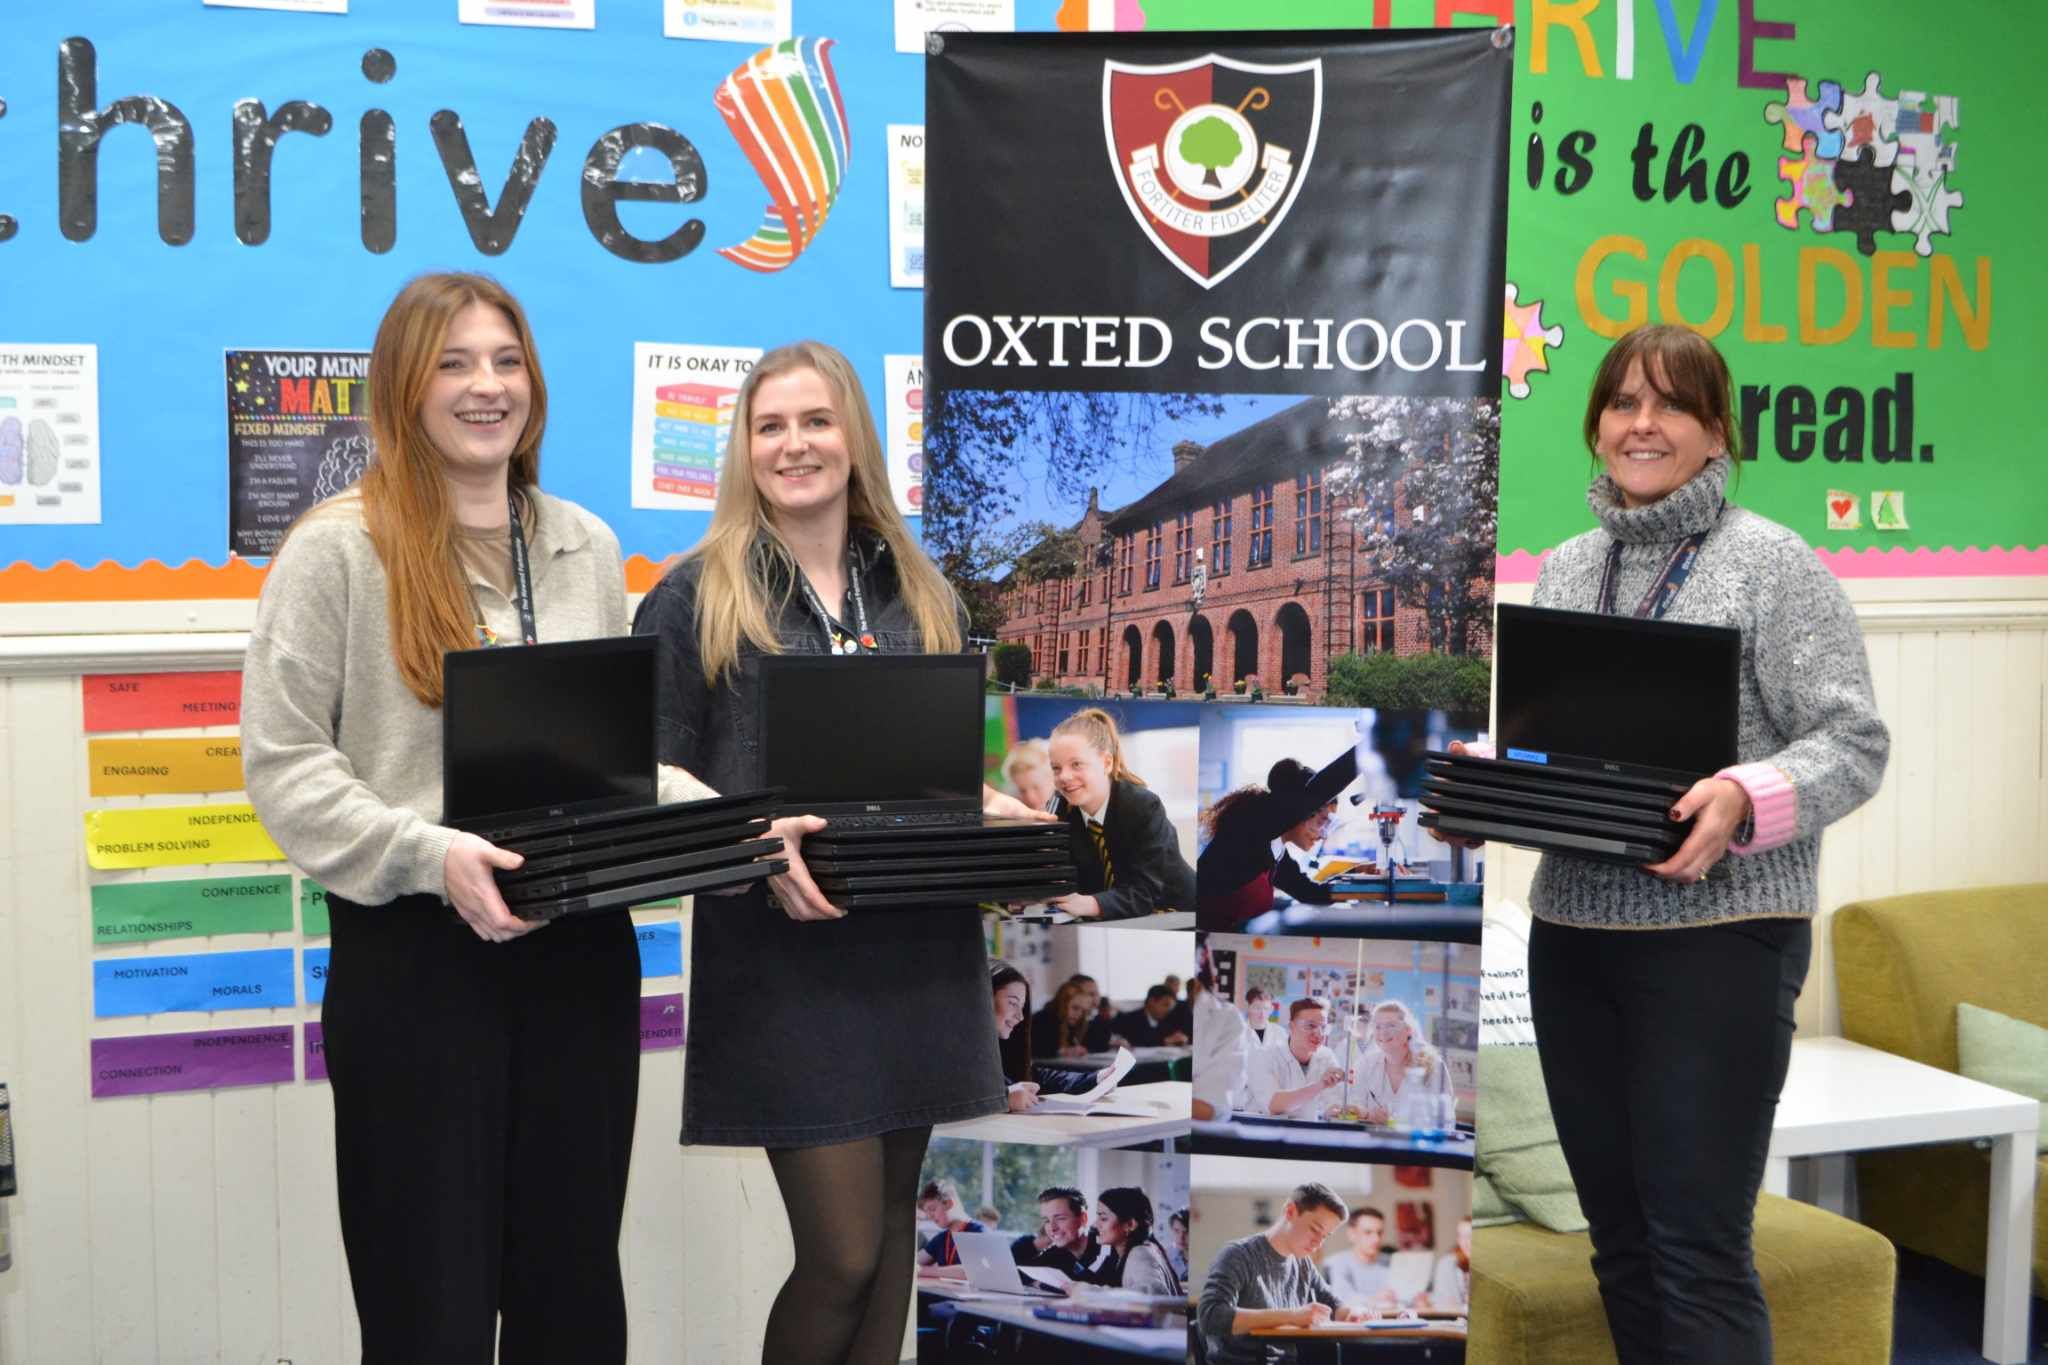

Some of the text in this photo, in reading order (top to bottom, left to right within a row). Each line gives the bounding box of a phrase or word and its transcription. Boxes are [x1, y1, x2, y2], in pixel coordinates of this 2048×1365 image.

[0, 36, 708, 264] hrive
[1526, 101, 1752, 209] is the
[1136, 169, 1286, 231] FORTITER FIDELITER
[1574, 235, 1992, 351] GOLDEN
[942, 314, 1487, 372] OXTED SCHOOL
[22, 355, 86, 367] MINDSET
[264, 355, 317, 377] YOUR
[648, 354, 663, 369] IT
[668, 355, 681, 370] IS
[686, 357, 730, 373] OKAY
[234, 421, 327, 436] FIXED MINDSET
[109, 682, 140, 693] SAFE
[182, 702, 237, 713] MEETING
[103, 765, 169, 777] ENGAGING
[96, 839, 210, 855] PROBLEM SOLVING
[201, 883, 282, 898] CONFIDENCE
[97, 920, 193, 936] RELATIONSHIPS
[113, 966, 189, 980] MOTIVATION
[212, 984, 263, 997] MORALS
[192, 1031, 289, 1048] INDEPENDENCE
[99, 1064, 182, 1081] CONNECTION
